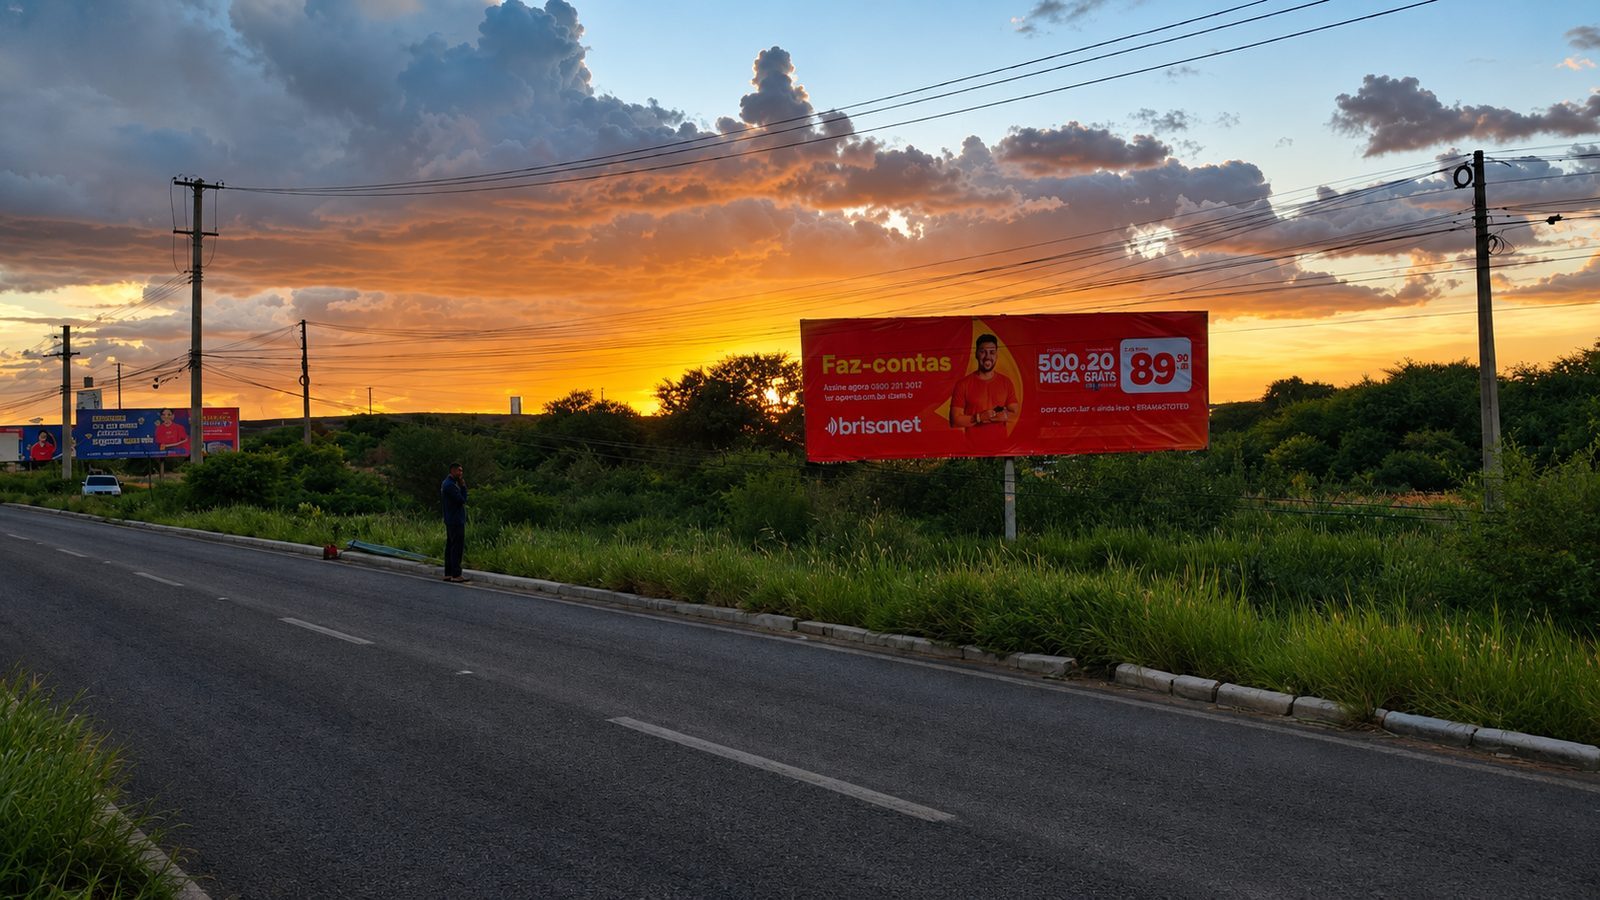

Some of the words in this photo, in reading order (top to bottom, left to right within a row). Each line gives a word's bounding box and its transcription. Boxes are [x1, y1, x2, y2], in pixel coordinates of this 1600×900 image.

[822, 353, 952, 375] Faz-contas
[1130, 352, 1176, 386] 89
[1040, 371, 1080, 384] MEGA
[839, 416, 922, 435] brisanet
